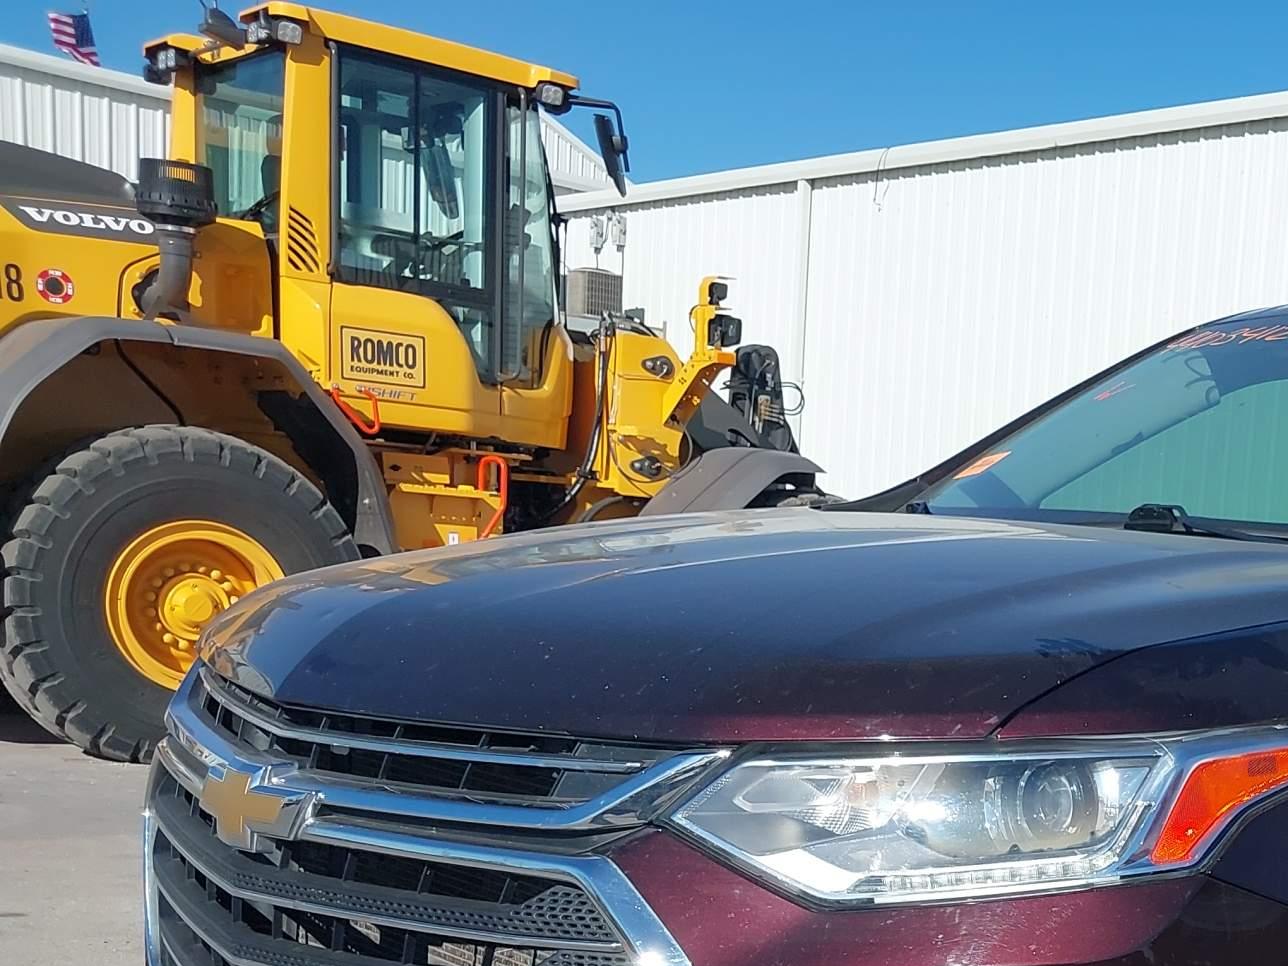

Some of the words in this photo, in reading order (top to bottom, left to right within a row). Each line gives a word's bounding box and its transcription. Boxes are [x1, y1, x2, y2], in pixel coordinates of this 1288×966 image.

[18, 205, 155, 234] VOLVO
[350, 335, 417, 370] ROMCO
[350, 364, 401, 378] EQUIPMENT
